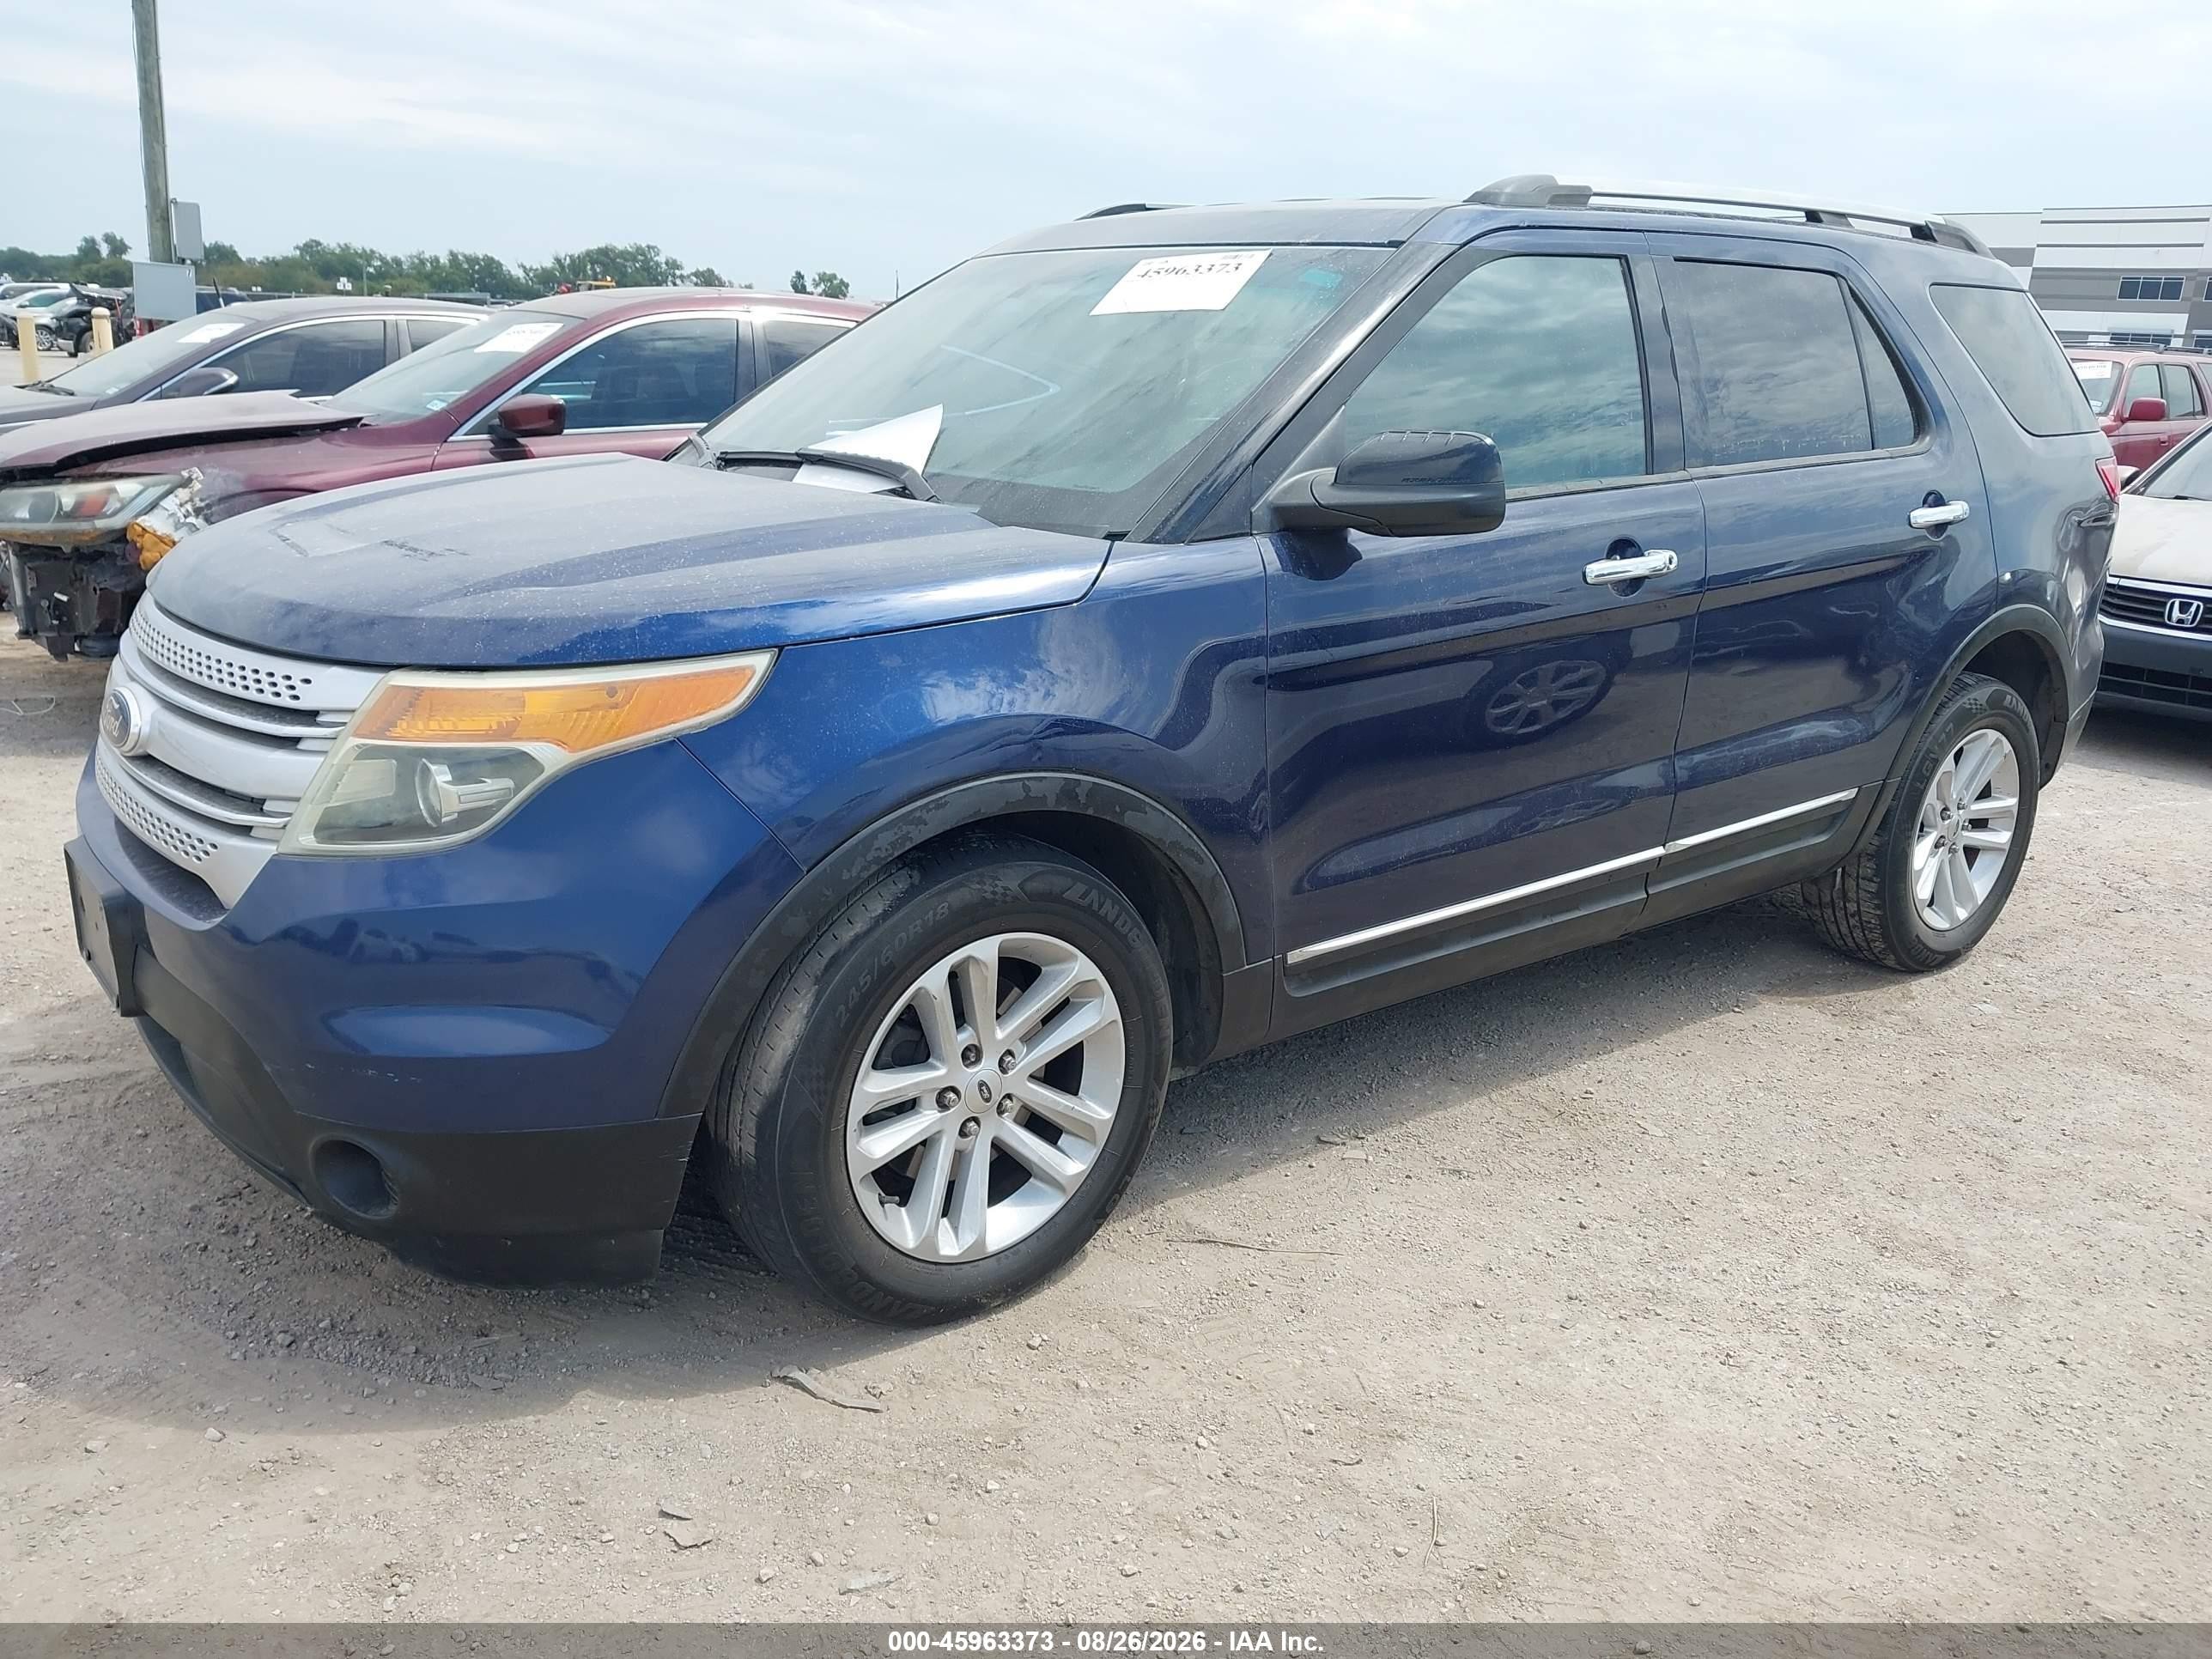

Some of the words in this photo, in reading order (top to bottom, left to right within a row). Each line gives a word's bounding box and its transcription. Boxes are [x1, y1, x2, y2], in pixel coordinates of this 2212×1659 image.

[1137, 263, 1243, 278] 45963373
[102, 696, 123, 738] Ford
[836, 902, 949, 1029] 245/60R18
